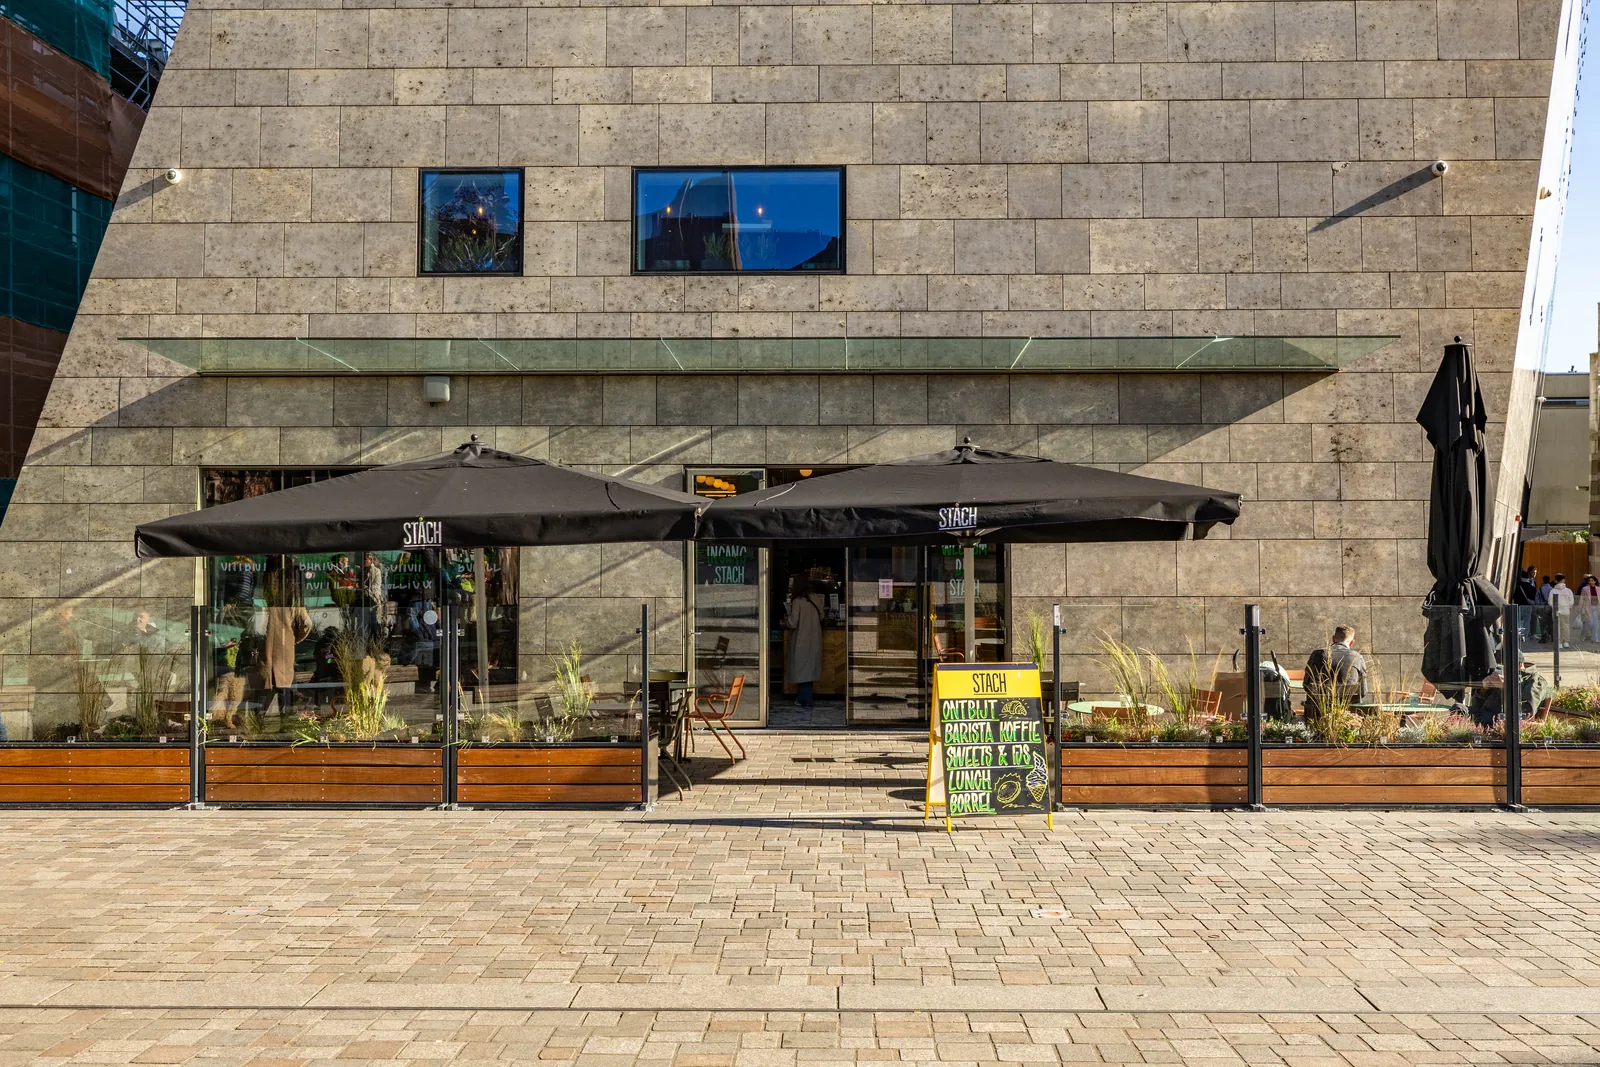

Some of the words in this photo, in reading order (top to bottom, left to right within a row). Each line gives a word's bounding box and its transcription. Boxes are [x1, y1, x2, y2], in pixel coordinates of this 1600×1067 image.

[938, 507, 977, 528] STACH
[403, 521, 442, 544] STACH
[706, 545, 748, 565] INGANG
[714, 566, 745, 584] STACH
[949, 579, 980, 596] STAH
[972, 673, 1007, 693] STACH
[942, 700, 998, 720] ONTBIJT
[945, 722, 995, 744] BARISTA
[1000, 721, 1041, 742] KOFFIE
[946, 745, 992, 767] SWEETS
[998, 745, 1008, 766] &
[1012, 744, 1031, 765] IJS
[949, 770, 992, 791] LUNCH
[950, 792, 996, 813] BORREL
